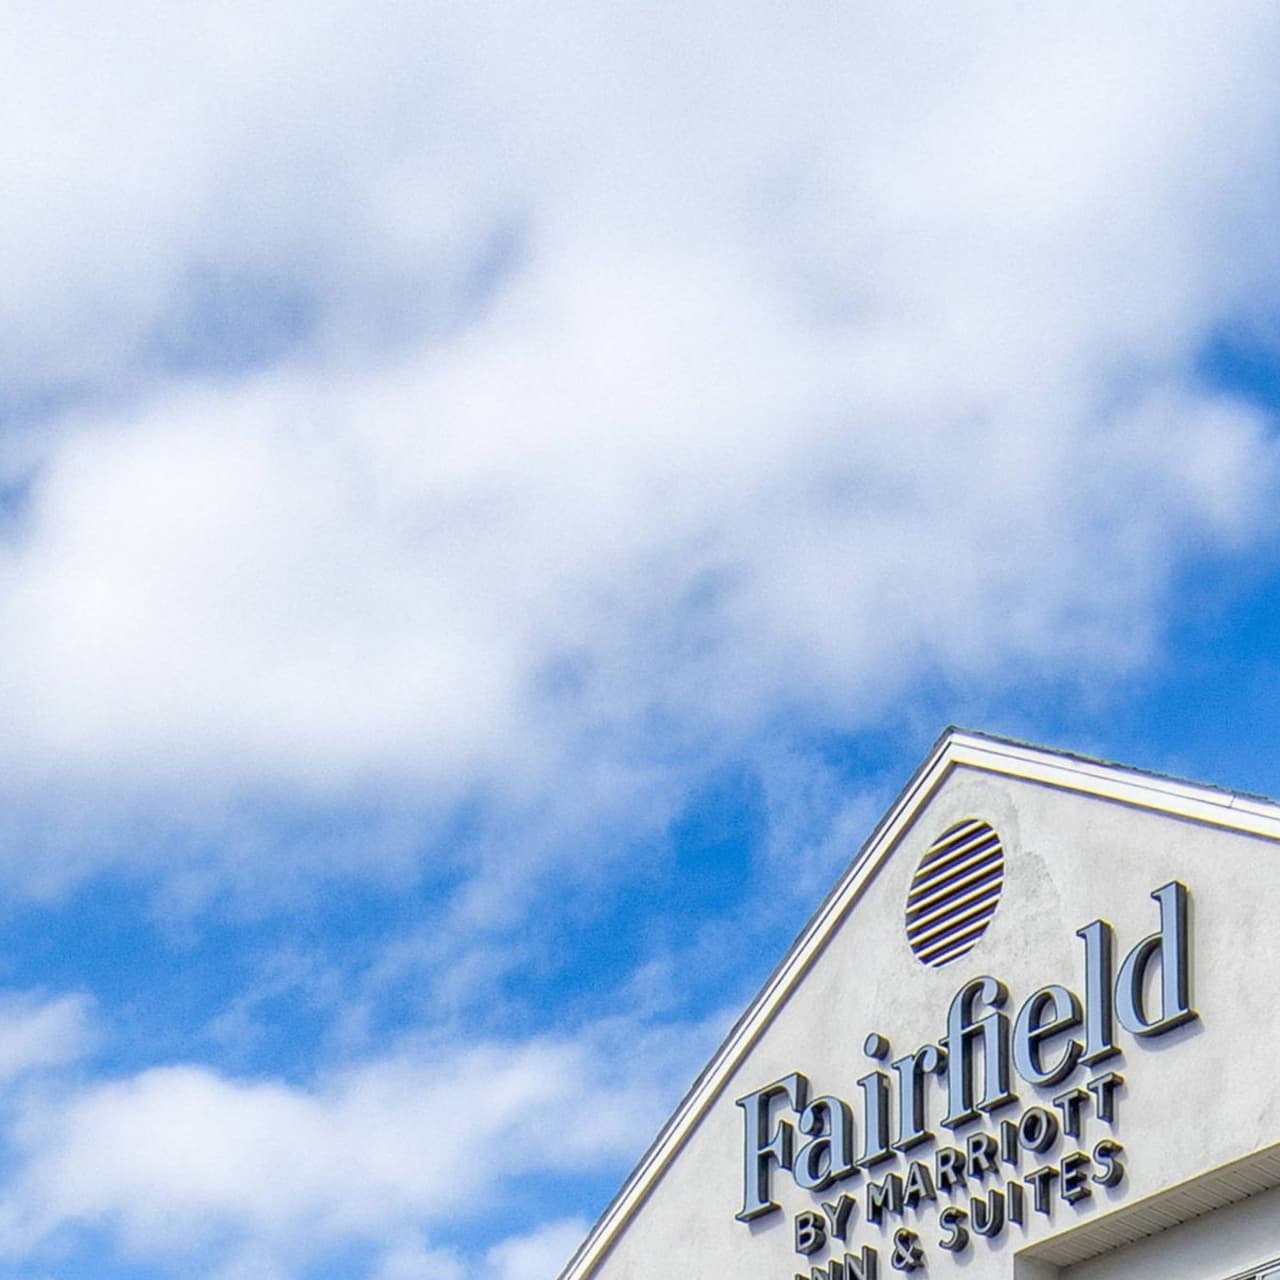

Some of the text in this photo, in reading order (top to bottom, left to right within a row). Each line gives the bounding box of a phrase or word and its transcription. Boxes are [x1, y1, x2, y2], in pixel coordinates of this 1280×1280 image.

[735, 880, 1199, 1223] Fairfield
[795, 1071, 1124, 1255] BY MARRIOTT
[891, 1227, 925, 1273] &
[939, 1138, 1124, 1252] SUITES
